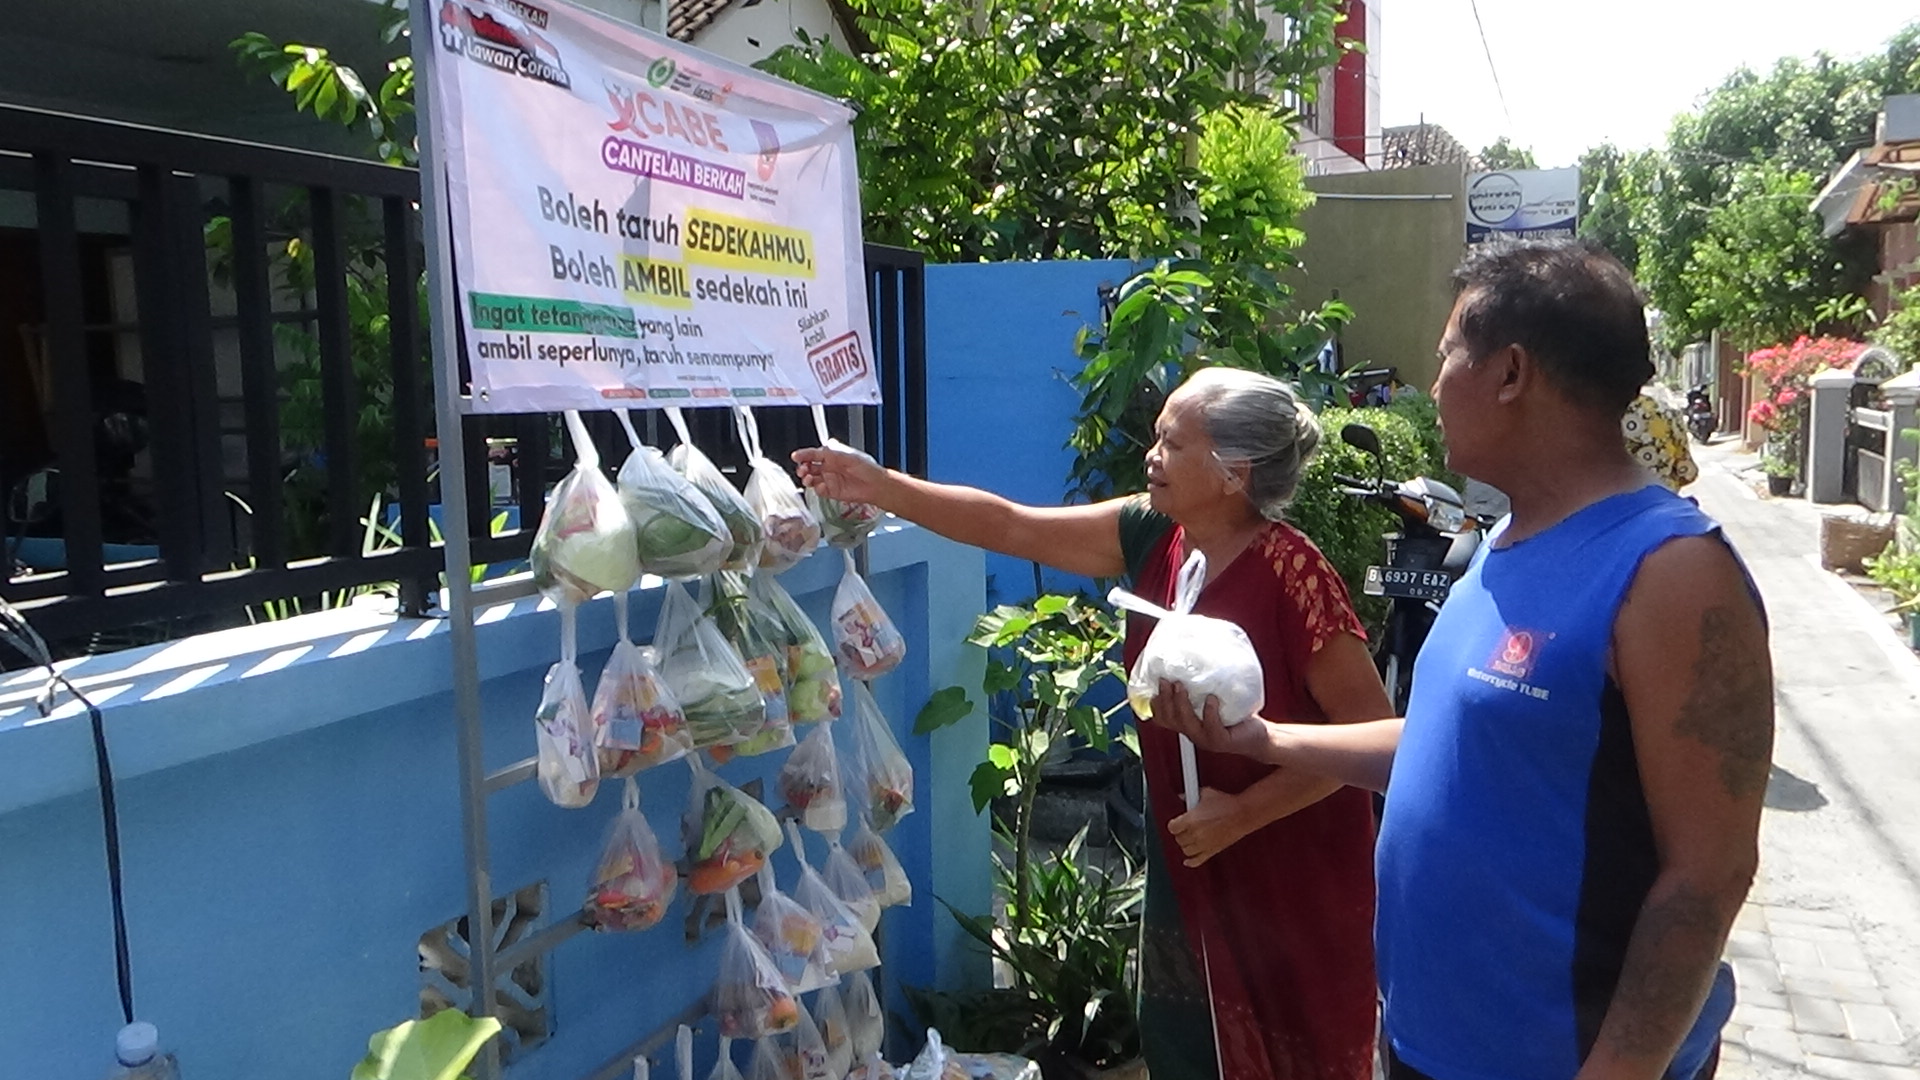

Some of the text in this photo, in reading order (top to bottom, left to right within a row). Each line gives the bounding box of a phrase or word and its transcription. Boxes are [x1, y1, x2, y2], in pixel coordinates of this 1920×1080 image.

[604, 140, 744, 195] CANTELAN BERKAH
[537, 184, 812, 270] Boleh taruh SEDEKAHMU,
[549, 244, 808, 309] Boleh AMBIL sedekah ini
[472, 301, 525, 329] Ingat
[638, 318, 674, 341] yang
[677, 315, 703, 337] lain
[798, 309, 829, 333] Silahkan
[803, 329, 827, 350] Ambil
[477, 334, 776, 371] ambil seperlunya, taruh semampunya
[815, 342, 859, 388] GRATIS
[1368, 569, 1378, 582] B
[1384, 570, 1417, 584] 6937
